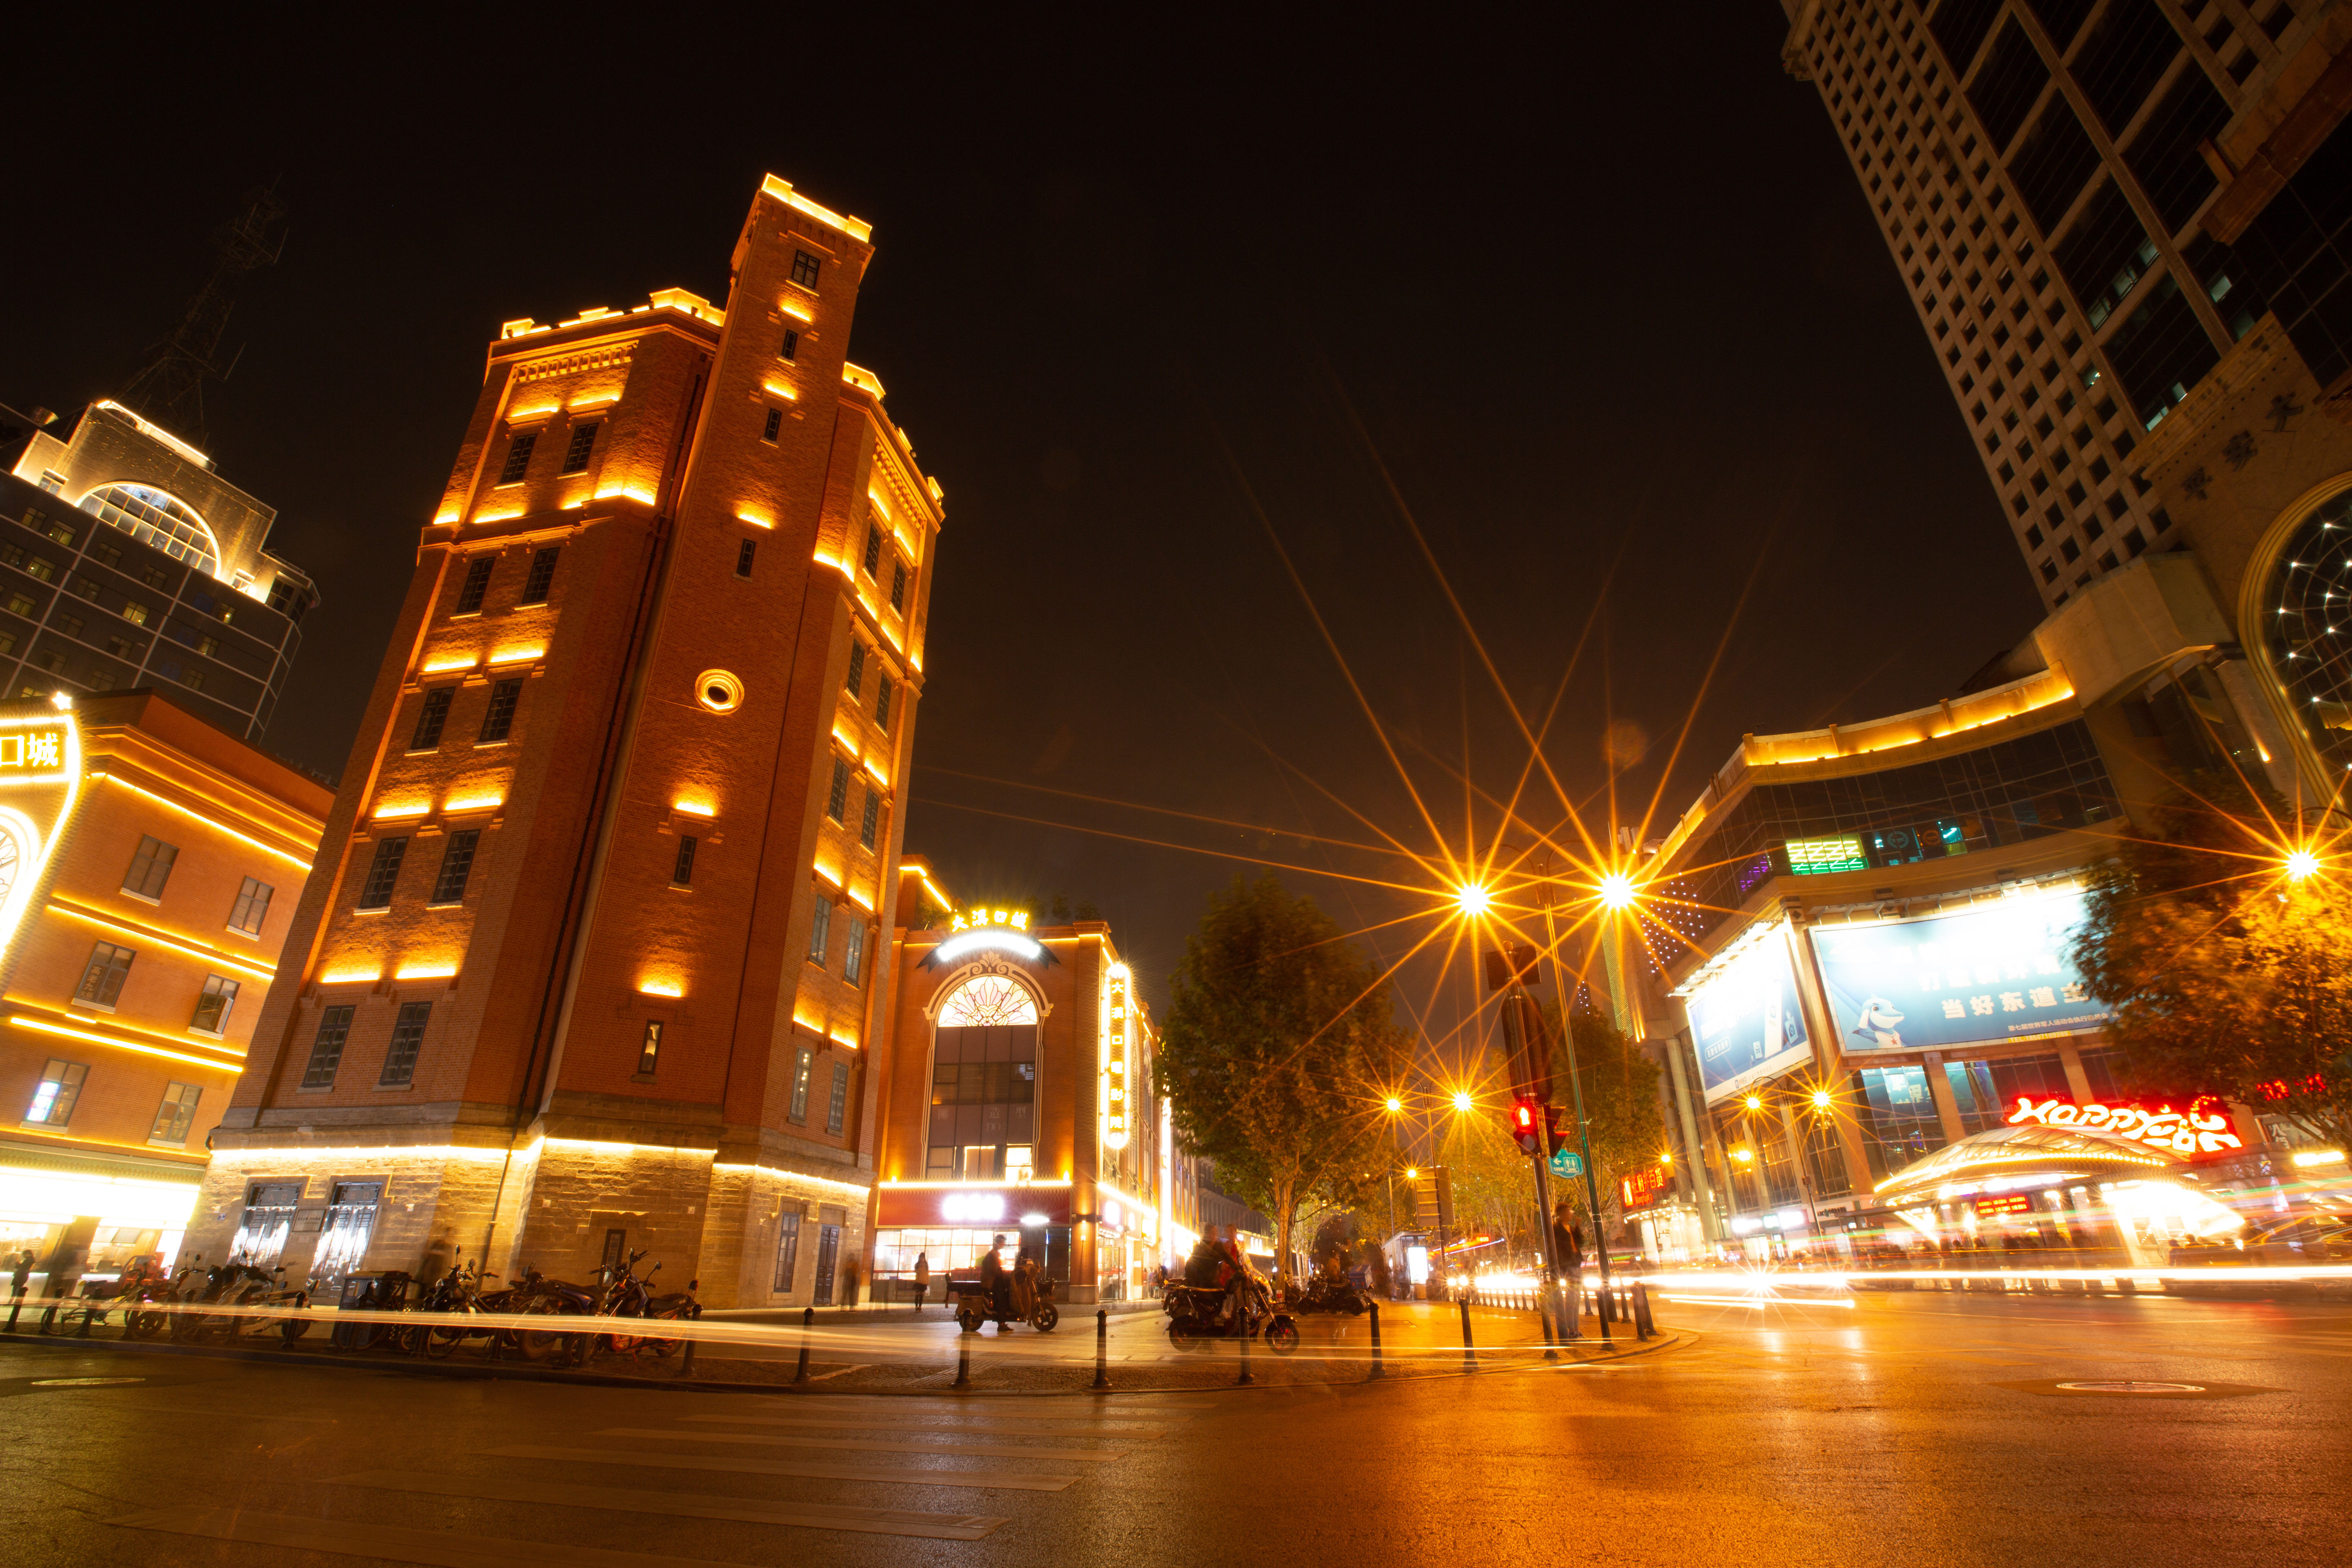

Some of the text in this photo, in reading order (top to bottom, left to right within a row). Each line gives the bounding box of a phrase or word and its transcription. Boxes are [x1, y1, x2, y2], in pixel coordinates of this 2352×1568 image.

[1941, 982, 2089, 1019] 当好东道主
[2008, 1012, 2109, 1032] 第七届世界军人运动会执行委员会
[349, 1191, 370, 1200] 出口
